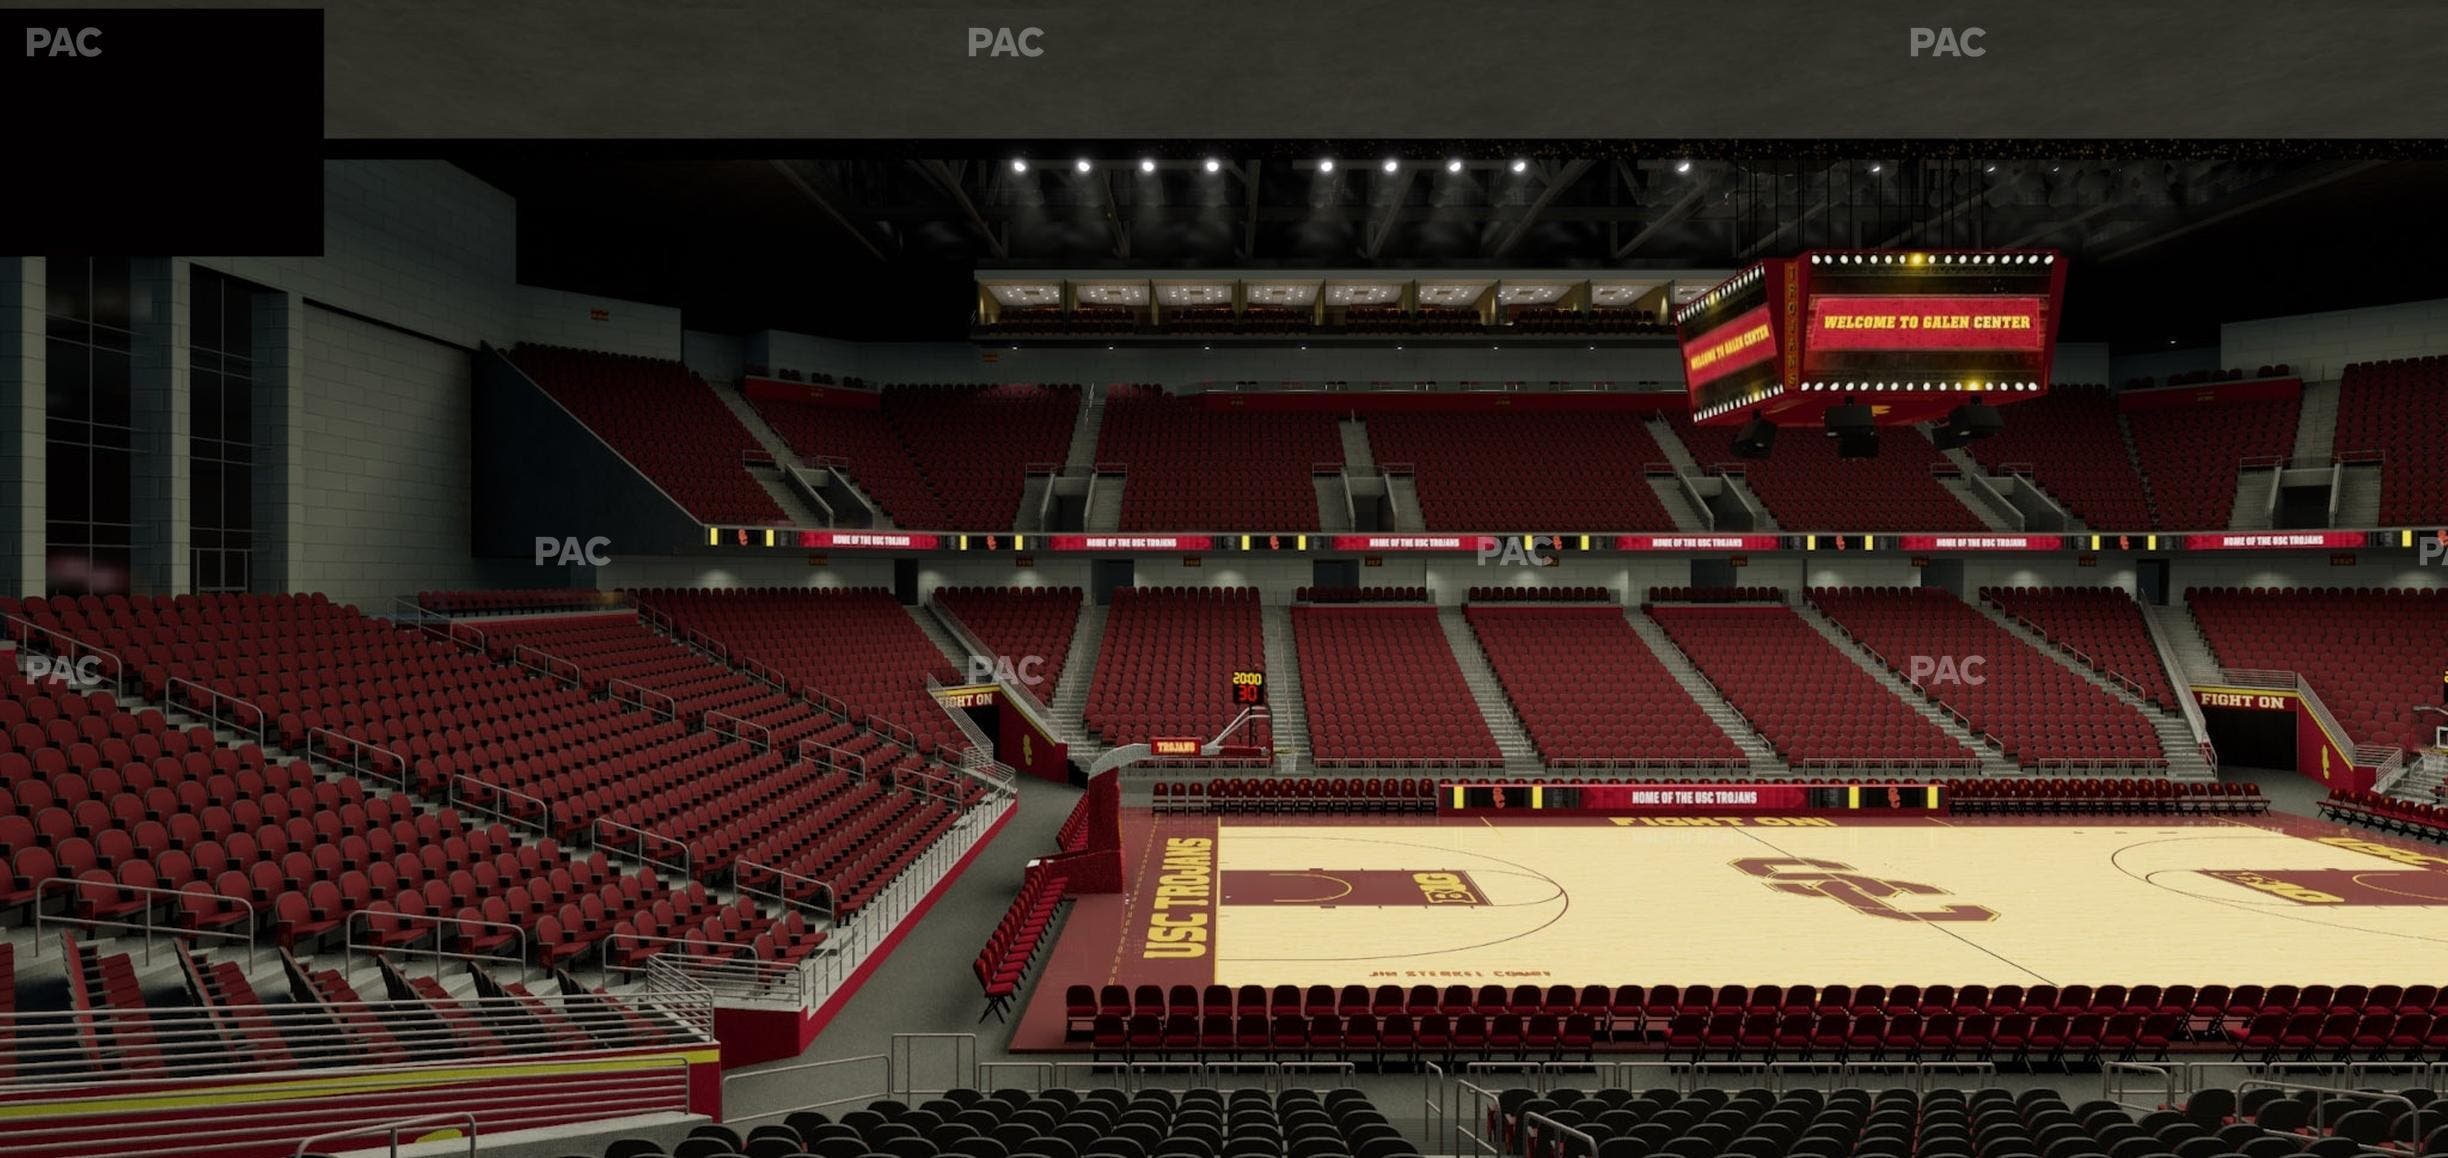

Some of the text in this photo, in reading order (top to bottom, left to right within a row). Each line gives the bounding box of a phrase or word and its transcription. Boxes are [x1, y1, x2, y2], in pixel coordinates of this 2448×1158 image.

[1824, 316, 2031, 329] WELCOME TO GALEN CENTER
[1233, 672, 1262, 685] 20:00
[976, 693, 993, 706] ON
[1239, 685, 1258, 701] 30
[2201, 693, 2285, 709] FIGHT ON
[1632, 790, 1757, 804] HOME OF THE USC TROJANS
[1608, 816, 1746, 827] FIGHT
[1143, 838, 1213, 958] USC TROJANS
